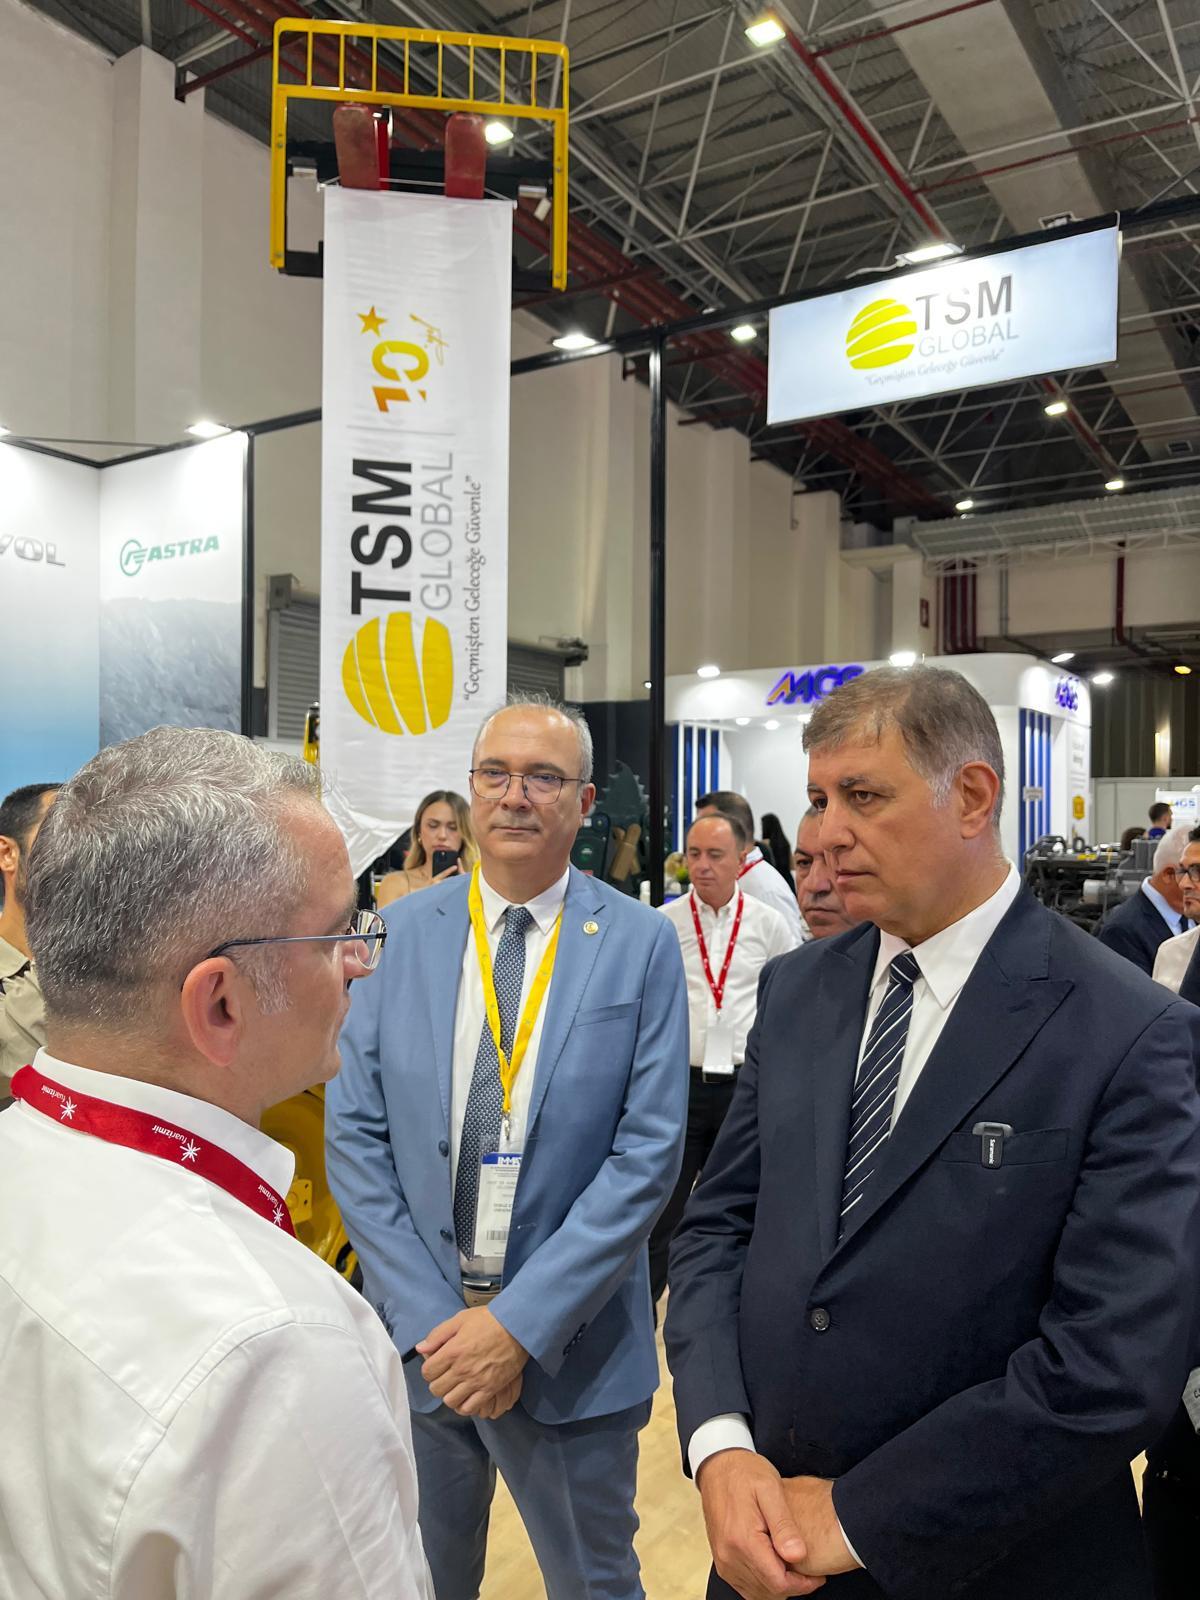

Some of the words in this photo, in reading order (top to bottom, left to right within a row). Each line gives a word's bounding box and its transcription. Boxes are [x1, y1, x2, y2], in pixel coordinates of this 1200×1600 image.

[915, 275, 1012, 331] TSM
[918, 318, 1019, 357] GLOBAL
[147, 534, 220, 562] ASTRA
[351, 458, 412, 616] TSM
[420, 453, 453, 611] GLOBAL
[462, 546, 486, 612] Geleceğe
[152, 1124, 187, 1145] fuarizmir
